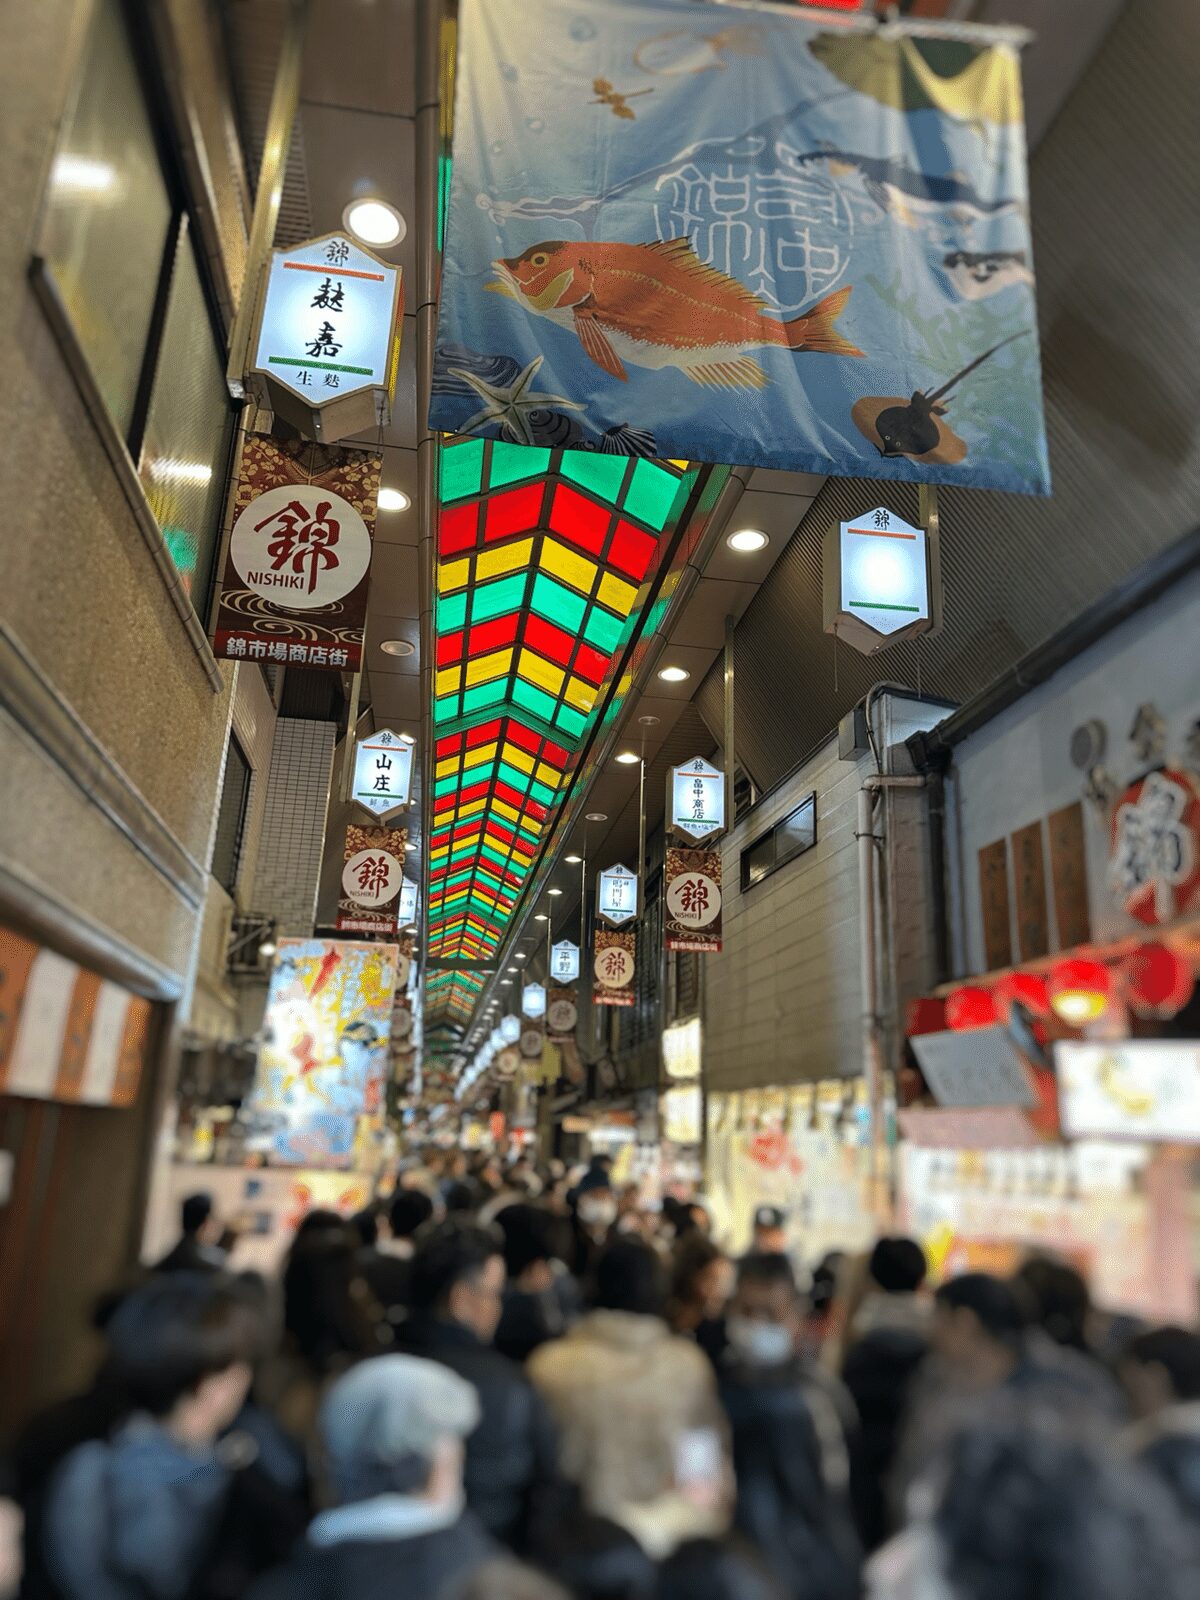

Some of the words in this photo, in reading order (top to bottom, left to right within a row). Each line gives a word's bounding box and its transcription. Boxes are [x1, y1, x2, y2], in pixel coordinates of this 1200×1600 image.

[870, 509, 890, 530] 錦
[253, 500, 341, 595] 錦
[247, 571, 304, 589] NISHIKI
[226, 637, 348, 667] 錦市場商店街
[373, 753, 392, 792] 山庄
[692, 778, 705, 819] 畠中商店
[352, 856, 390, 900] 錦
[350, 890, 375, 898] NISHIKI
[674, 879, 709, 920] 錦
[674, 911, 697, 919] NISHIKI
[601, 952, 626, 982] 錦
